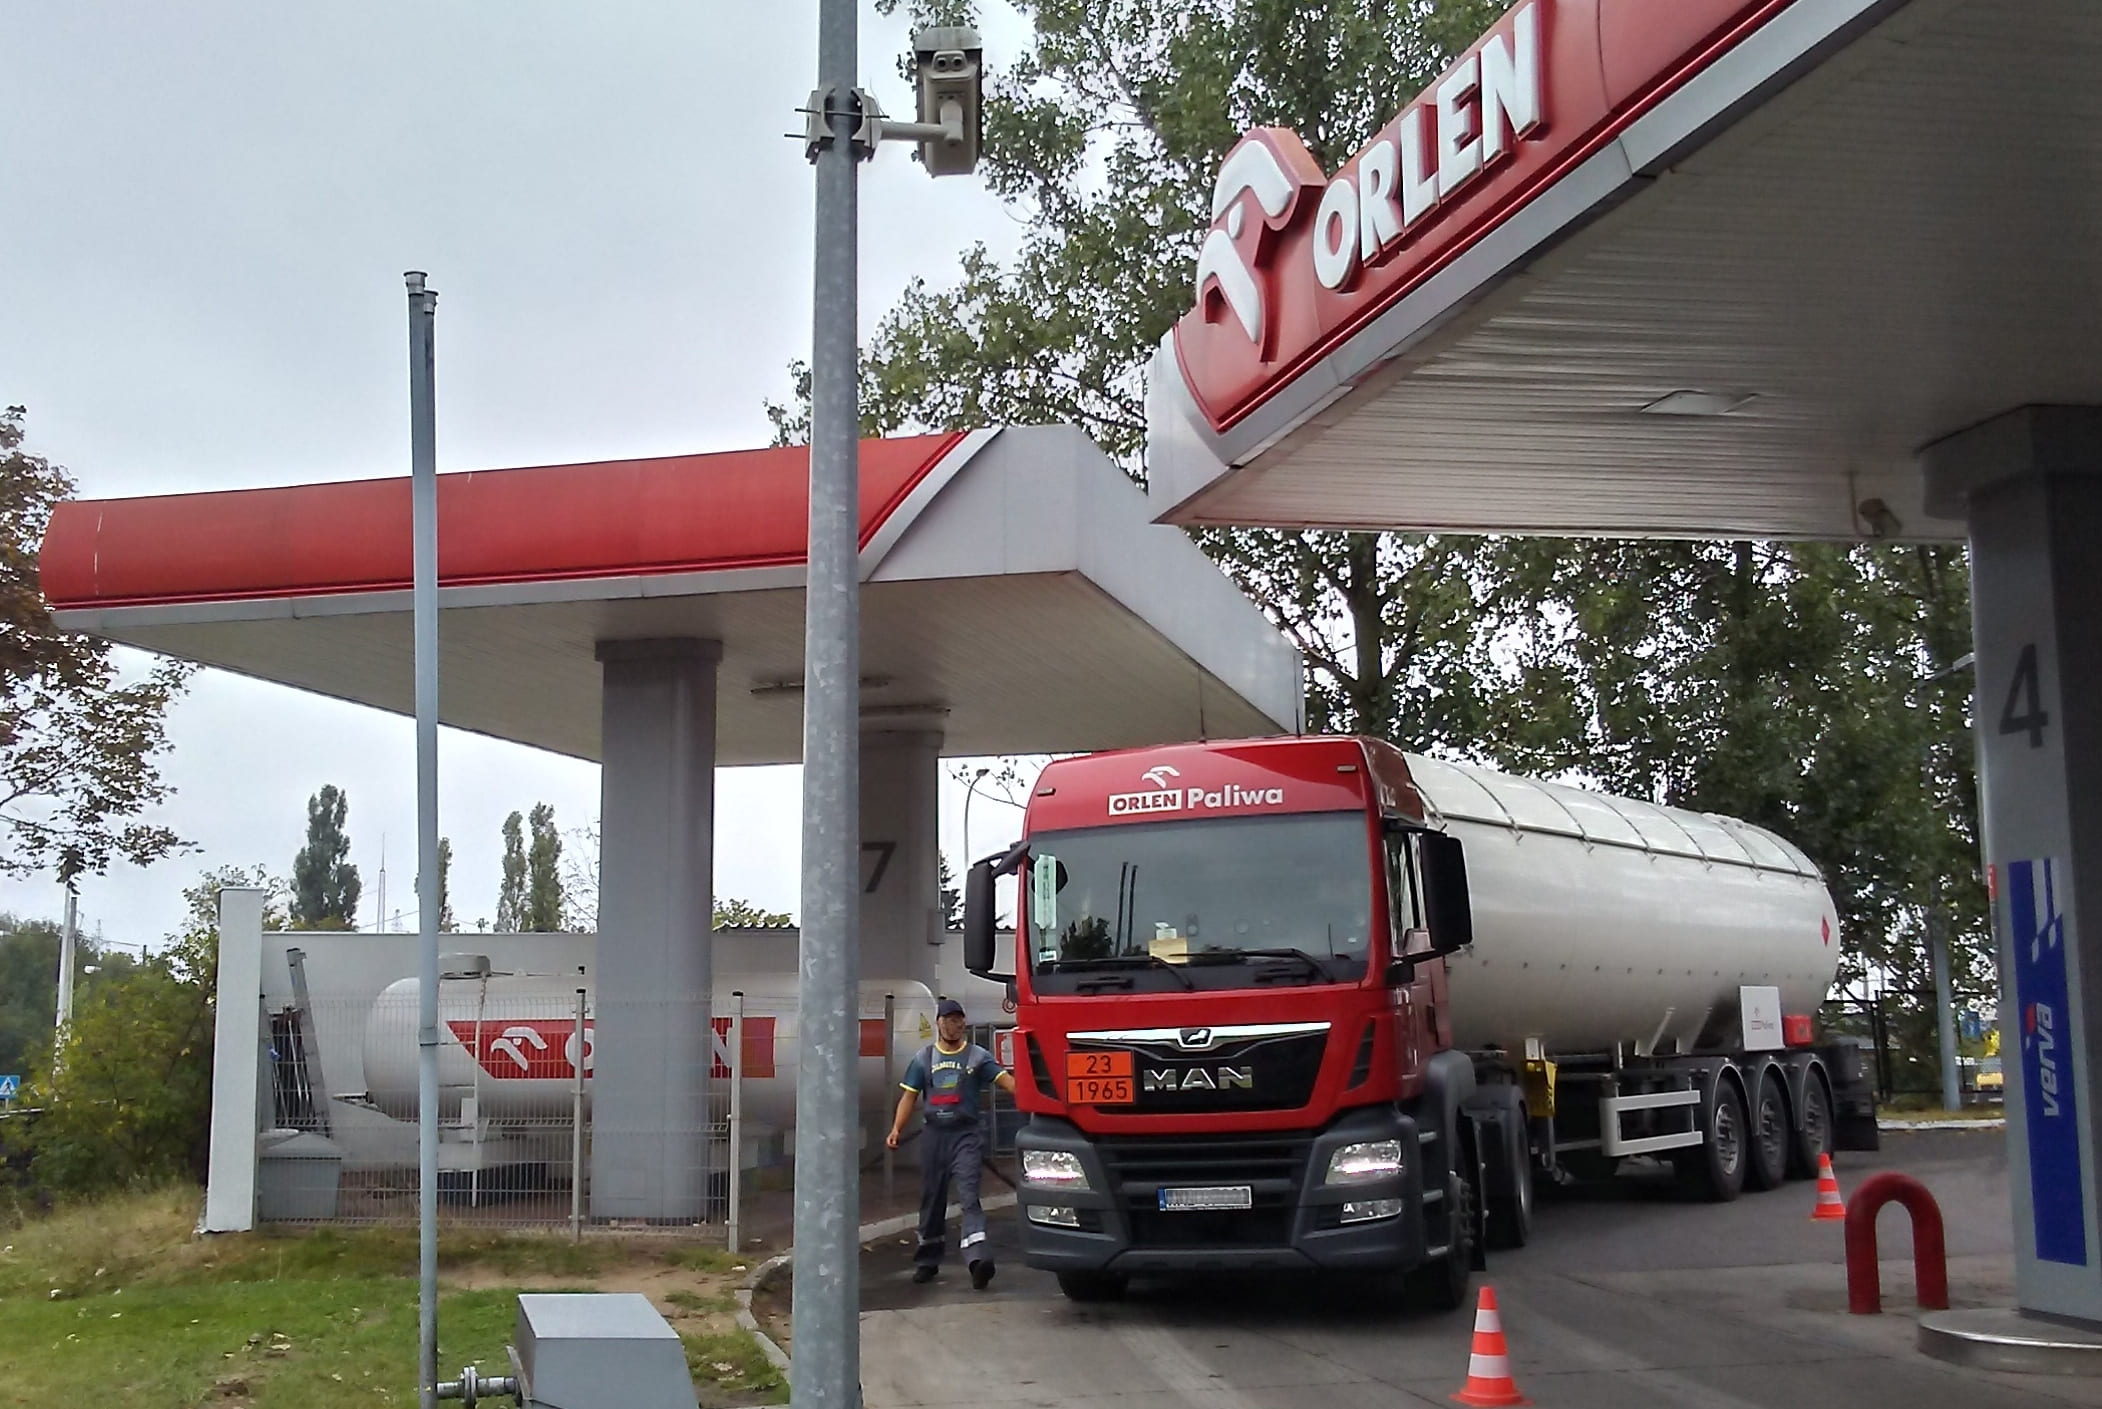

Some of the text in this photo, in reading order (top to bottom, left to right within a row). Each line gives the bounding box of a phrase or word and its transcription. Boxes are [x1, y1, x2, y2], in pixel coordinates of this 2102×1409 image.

[1313, 1, 1543, 290] ORLEN
[1999, 643, 2048, 750] 4
[1113, 785, 1283, 812] ORLEN Paliwa
[861, 841, 898, 893] 7
[1086, 1055, 1112, 1074] 23
[1143, 1066, 1253, 1091] MAN
[2036, 1002, 2060, 1116] verva
[1076, 1081, 1128, 1100] 1965
